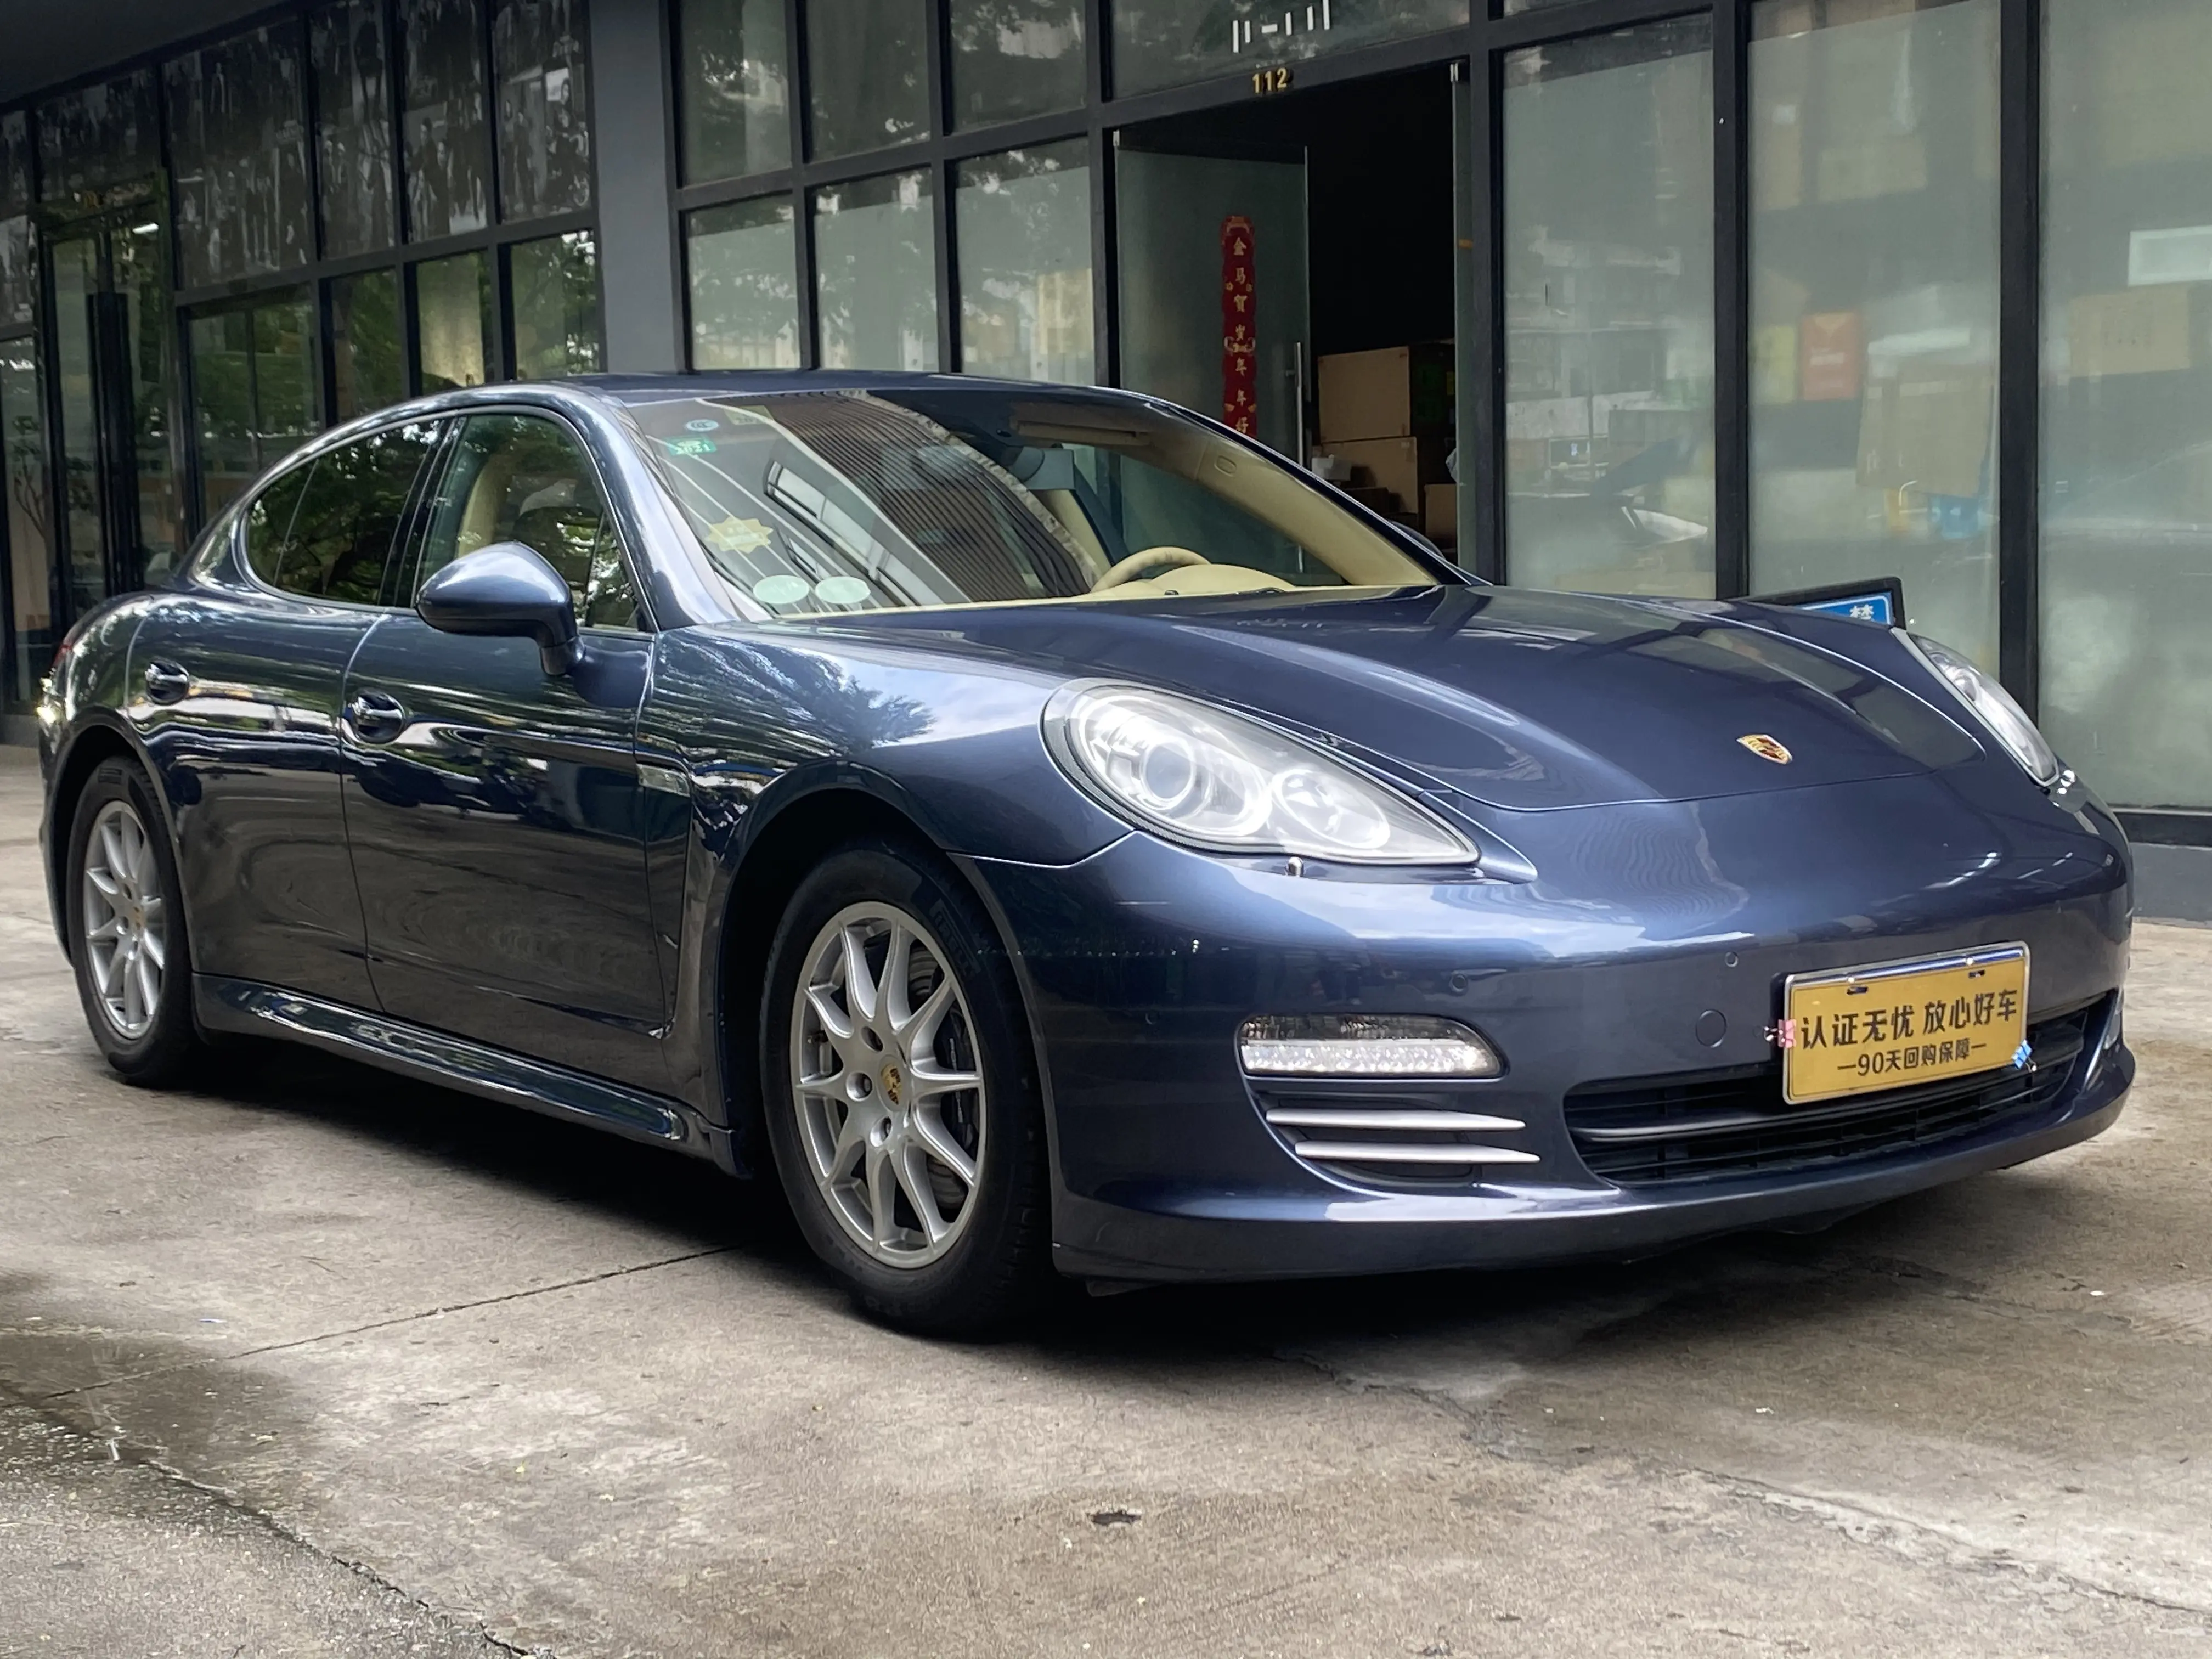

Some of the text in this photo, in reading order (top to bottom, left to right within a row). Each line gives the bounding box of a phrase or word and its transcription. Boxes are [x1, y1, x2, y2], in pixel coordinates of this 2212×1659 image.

[1252, 67, 1287, 94] 112
[1801, 989, 2018, 1050] 认证无忧 放心好车
